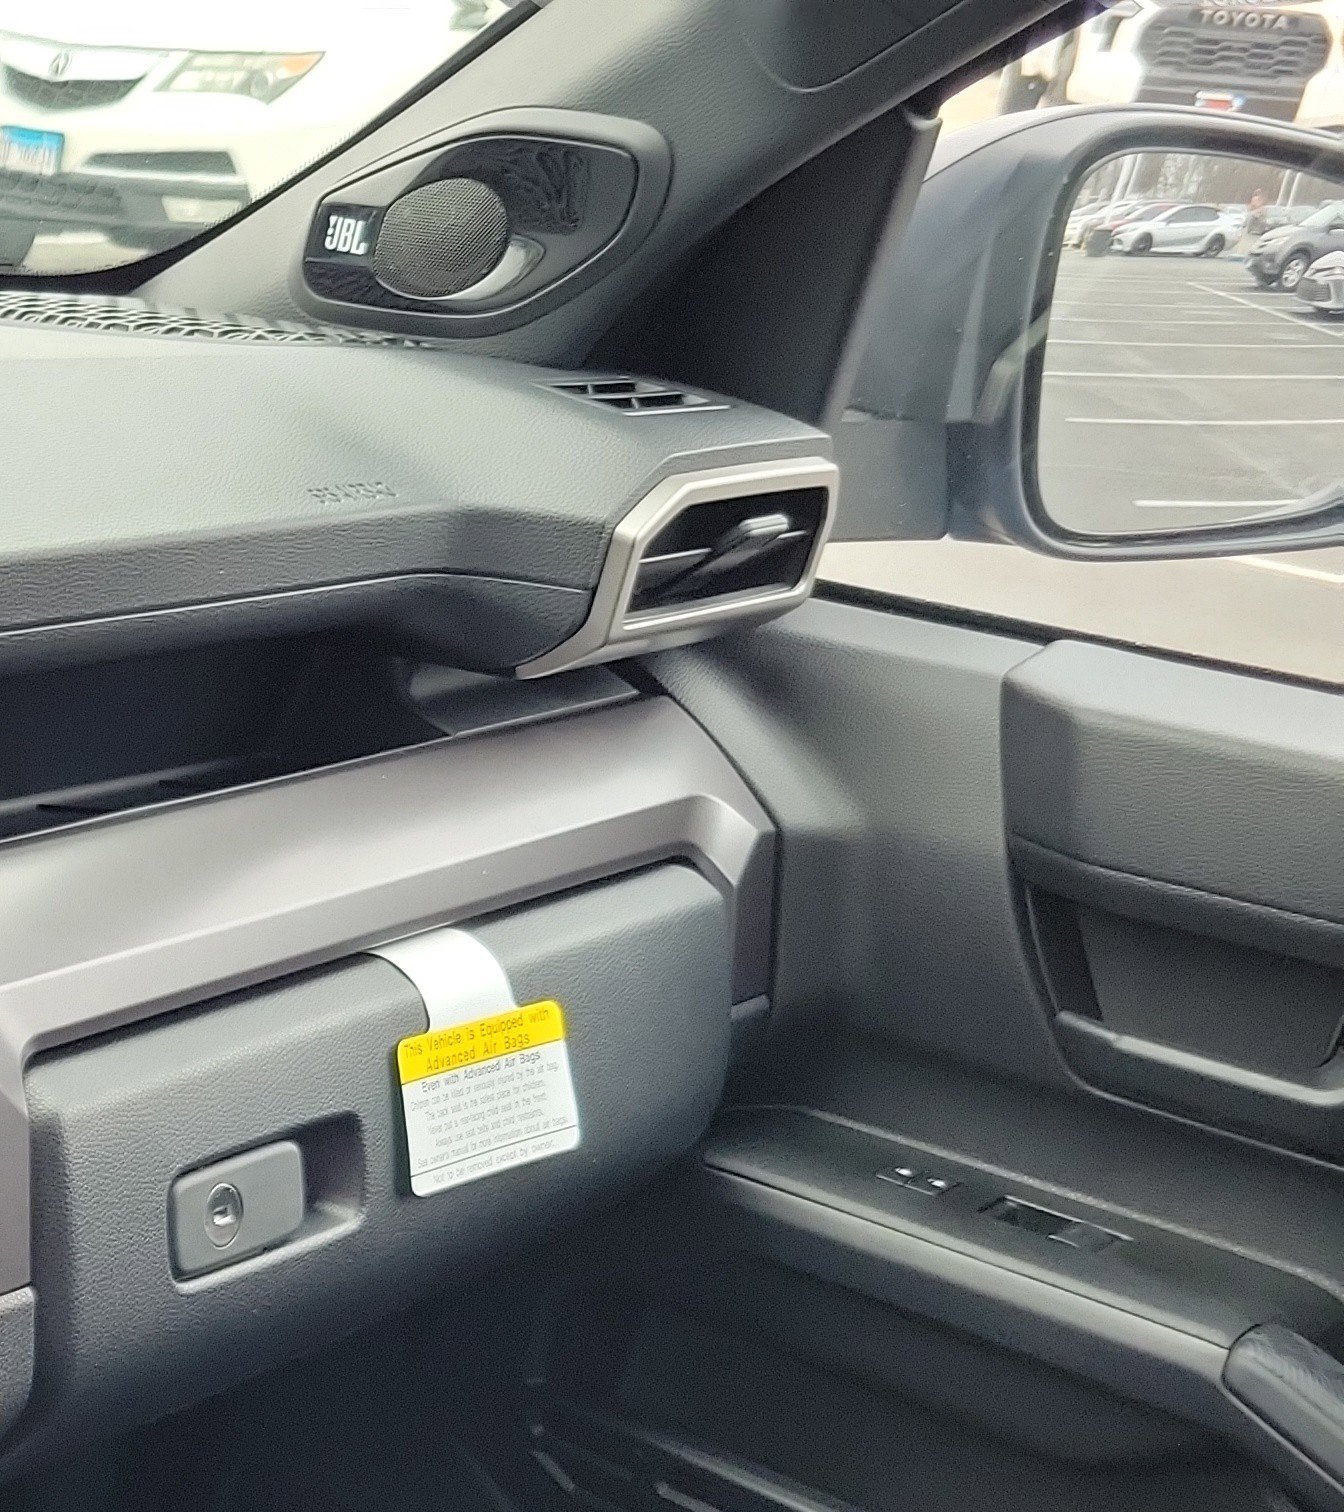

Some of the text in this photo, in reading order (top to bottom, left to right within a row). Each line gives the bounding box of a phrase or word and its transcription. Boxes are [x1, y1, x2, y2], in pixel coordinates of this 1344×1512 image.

[1199, 9, 1291, 30] TOYOTA
[324, 215, 369, 255] JBL
[404, 1007, 549, 1058] This Vehicle is Equipped with
[425, 1030, 530, 1072] Advanced Air Bags
[421, 1049, 540, 1092] Even with Advanced Air Bags
